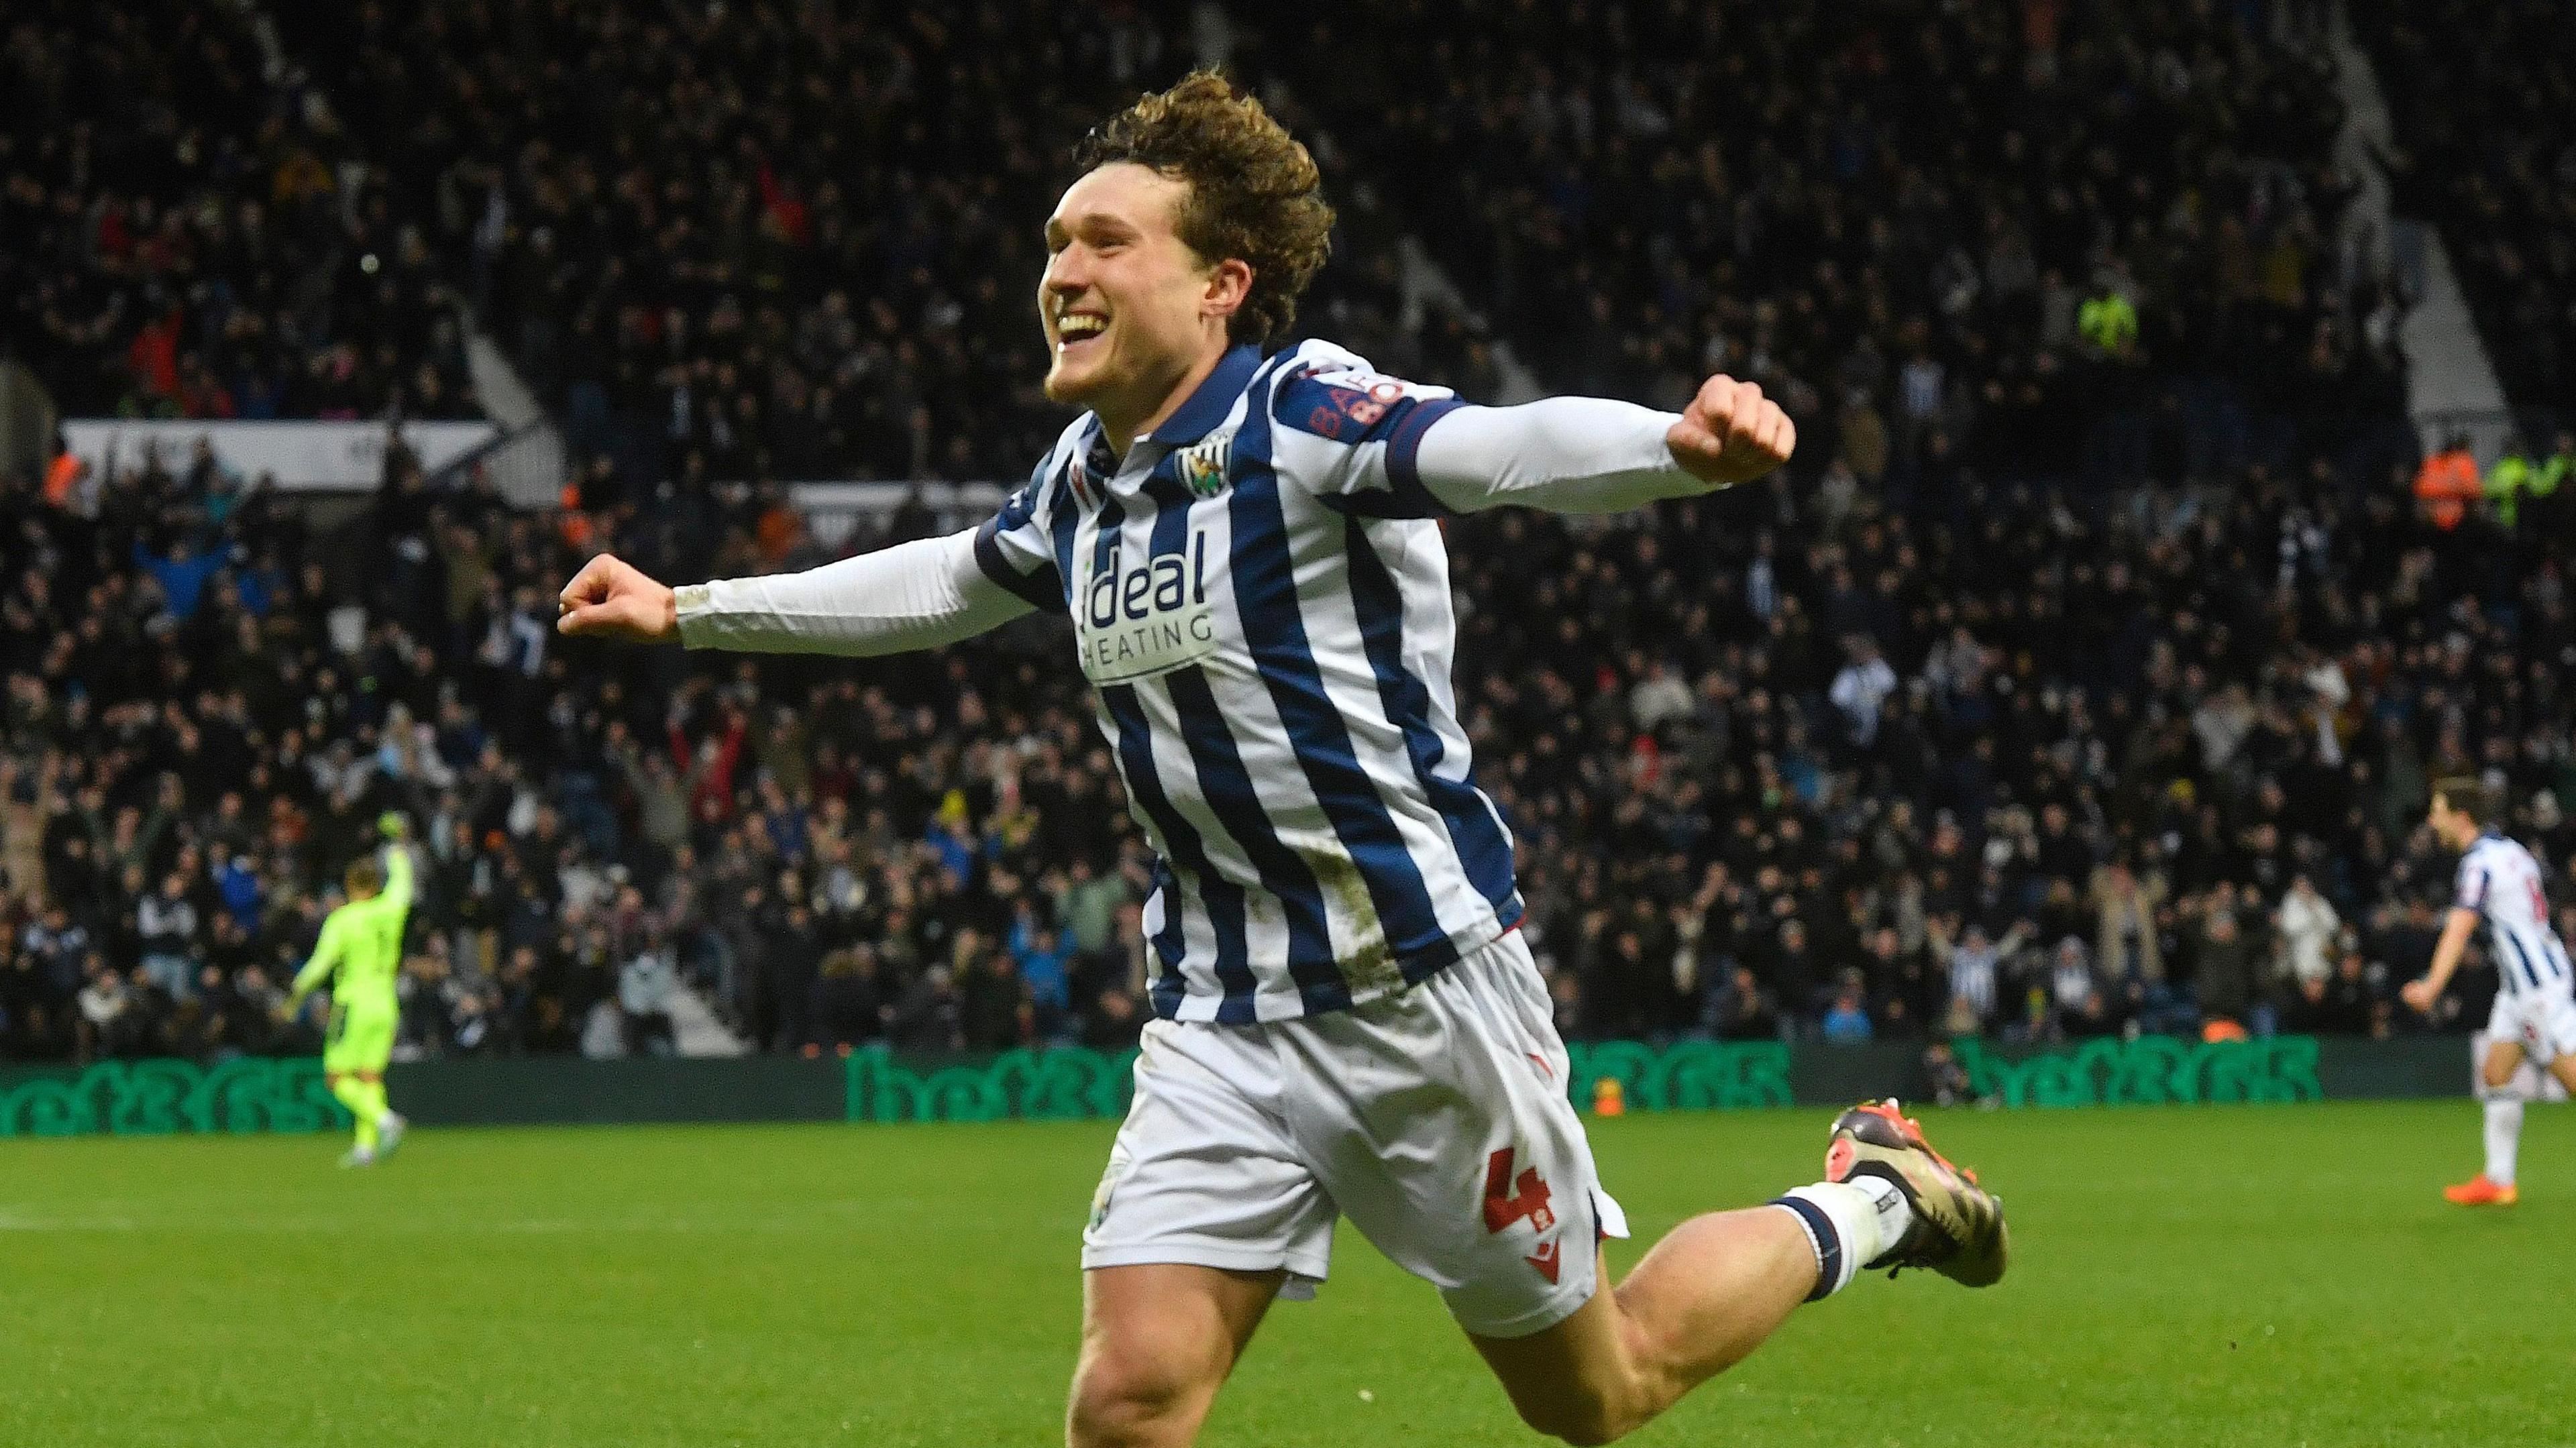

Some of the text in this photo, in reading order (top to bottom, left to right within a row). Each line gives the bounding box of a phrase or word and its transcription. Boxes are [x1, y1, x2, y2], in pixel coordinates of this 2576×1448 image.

[1079, 531, 1205, 633] ideal
[1083, 614, 1212, 667] HEATING
[1949, 1036, 2324, 1108] bet365
[1483, 1147, 1556, 1234] 4
